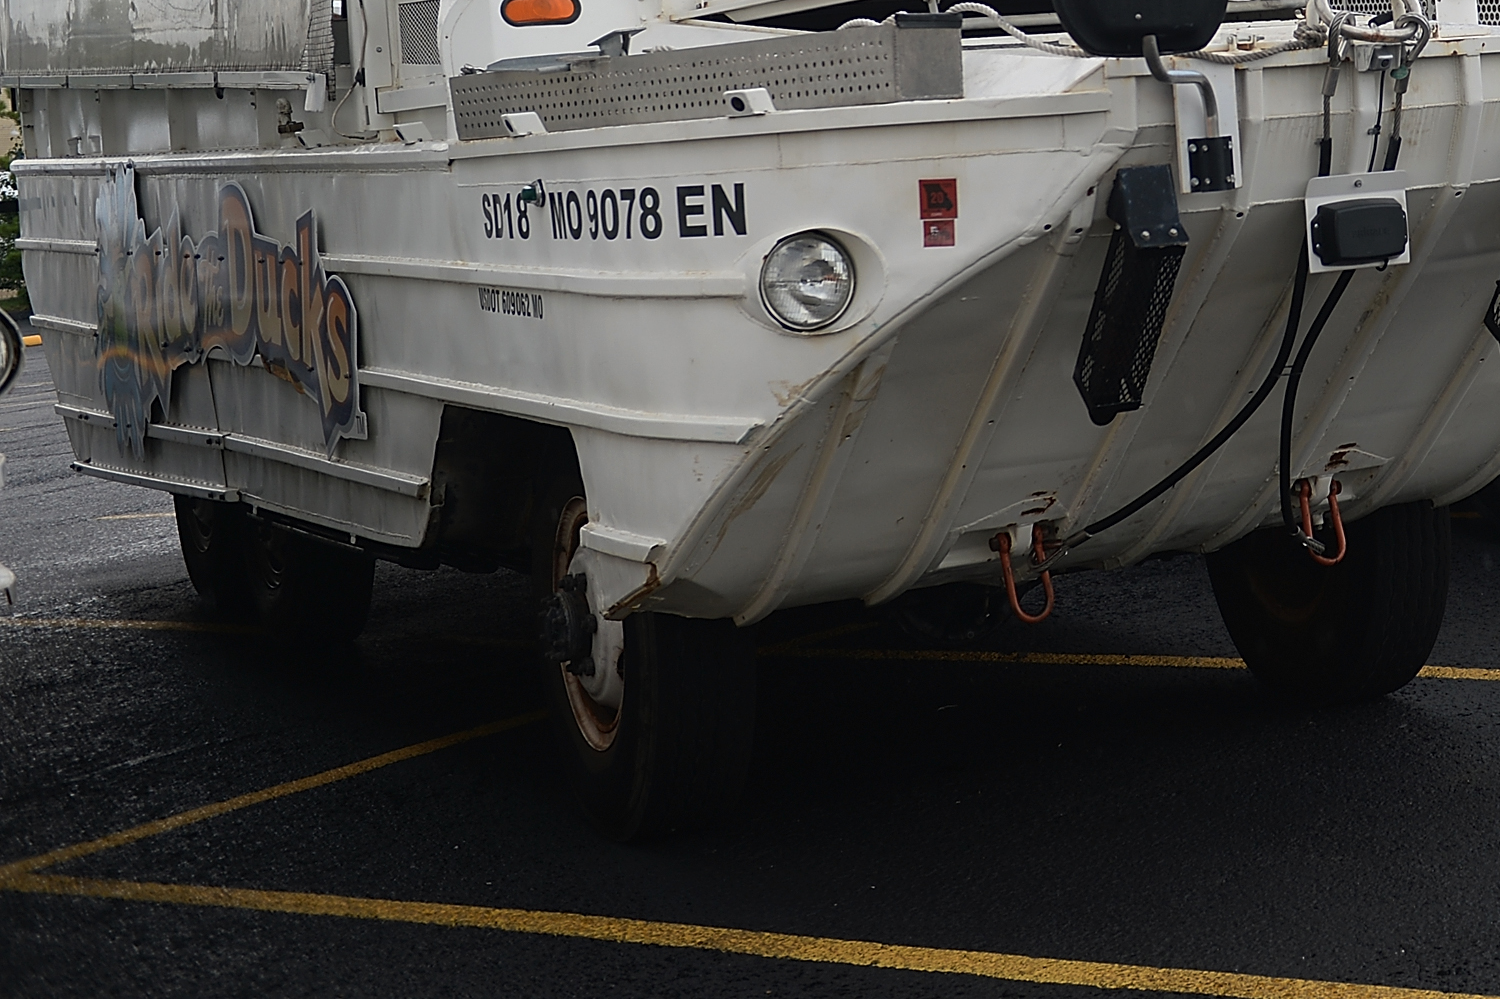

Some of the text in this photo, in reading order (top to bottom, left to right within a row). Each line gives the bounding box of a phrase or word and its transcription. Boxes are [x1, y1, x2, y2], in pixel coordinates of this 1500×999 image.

[482, 193, 531, 240] SD18
[676, 183, 747, 238] EN
[931, 192, 944, 204] 20
[131, 228, 196, 388] Ride
[220, 196, 350, 416] Ducks
[478, 287, 544, 319] USDOT 609062 MO
